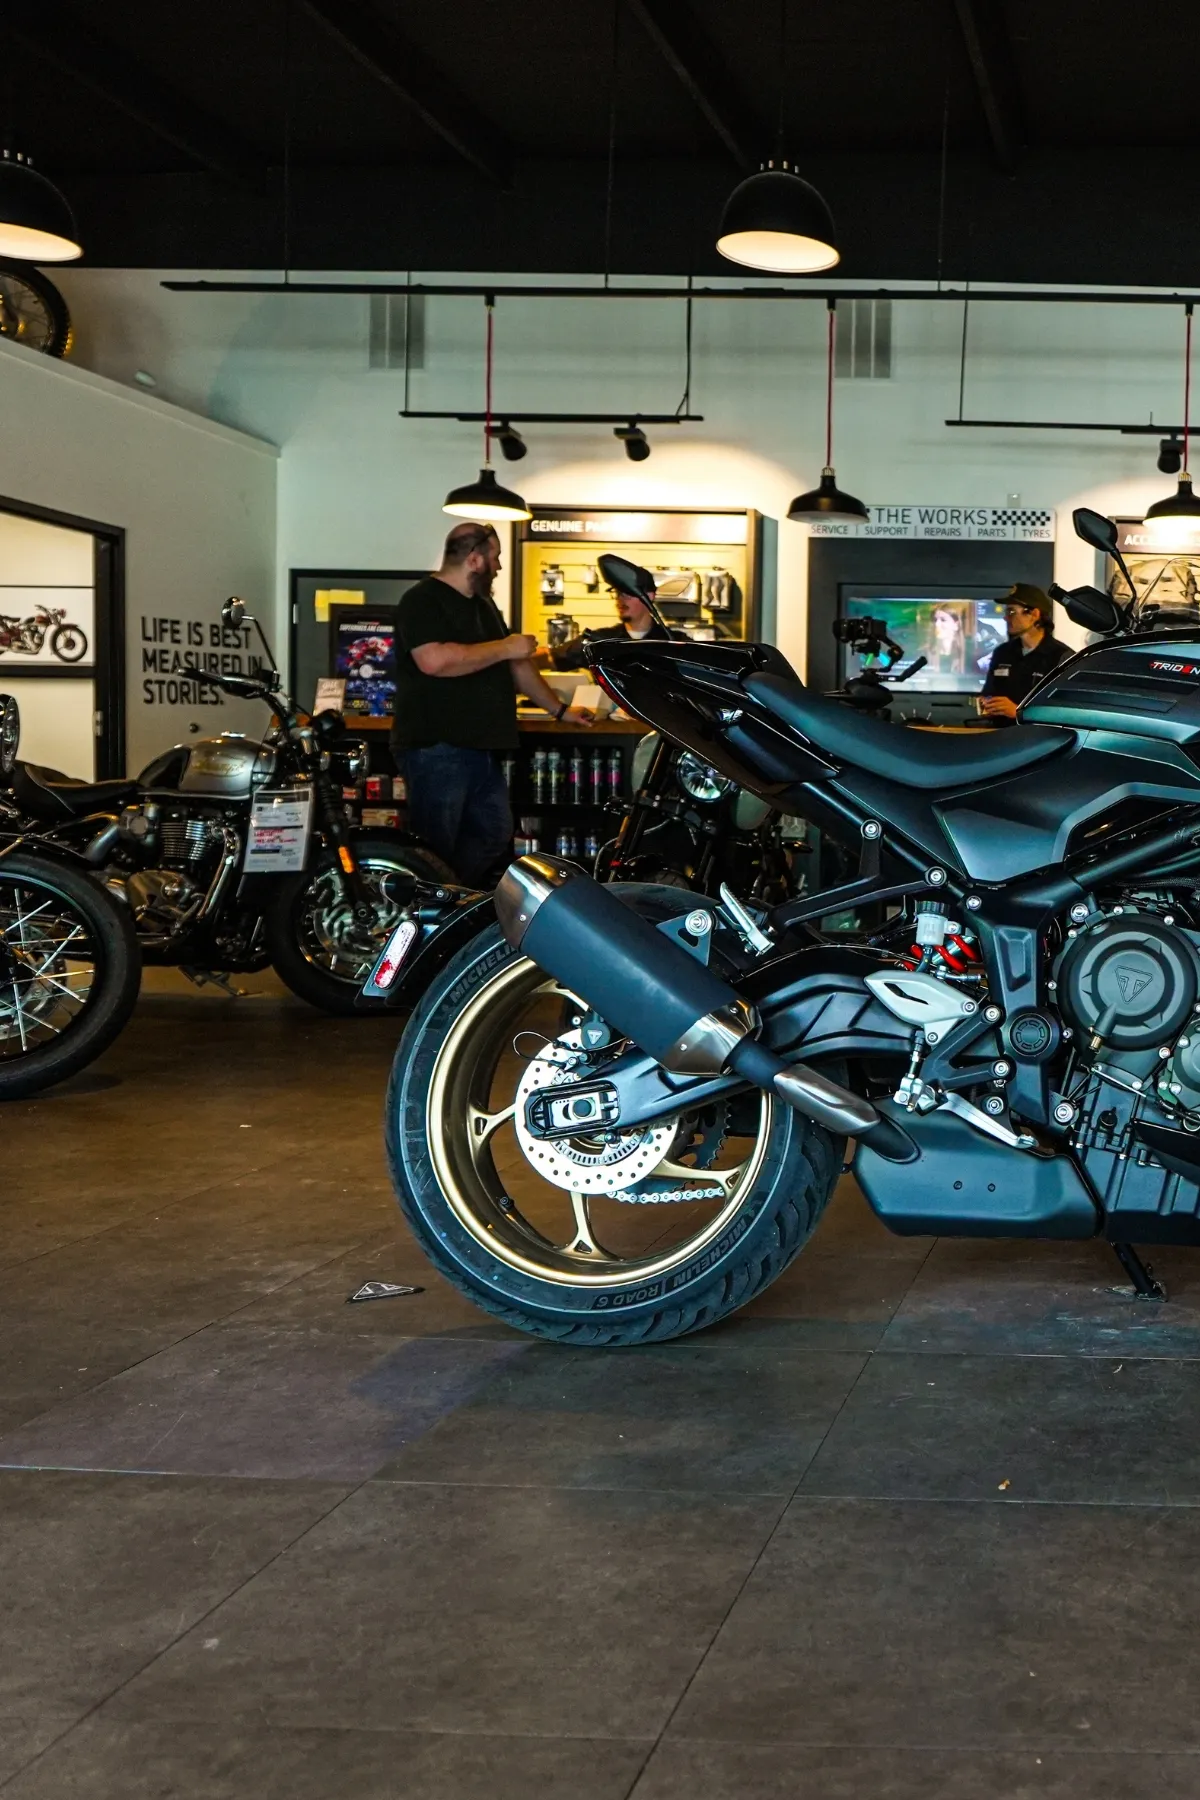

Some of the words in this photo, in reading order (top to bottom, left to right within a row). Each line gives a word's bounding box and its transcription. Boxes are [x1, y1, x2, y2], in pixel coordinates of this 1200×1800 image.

[531, 520, 584, 532] GENUINE
[875, 507, 912, 524] THE
[918, 508, 988, 526] WORKS
[811, 524, 848, 535] SERVICE
[864, 526, 909, 536] SUPPORT
[924, 527, 962, 537] REPAIRS
[977, 528, 1006, 537] PARTS
[1023, 529, 1051, 538] TYRES
[141, 616, 181, 643] LIFE
[187, 621, 203, 646] IS
[209, 624, 251, 649] BEST
[142, 648, 242, 675] MEASURED
[248, 656, 262, 675] IN
[673, 1217, 748, 1288] MICHELIN
[596, 1296, 609, 1308] 6
[612, 1284, 659, 1307] ROAD
